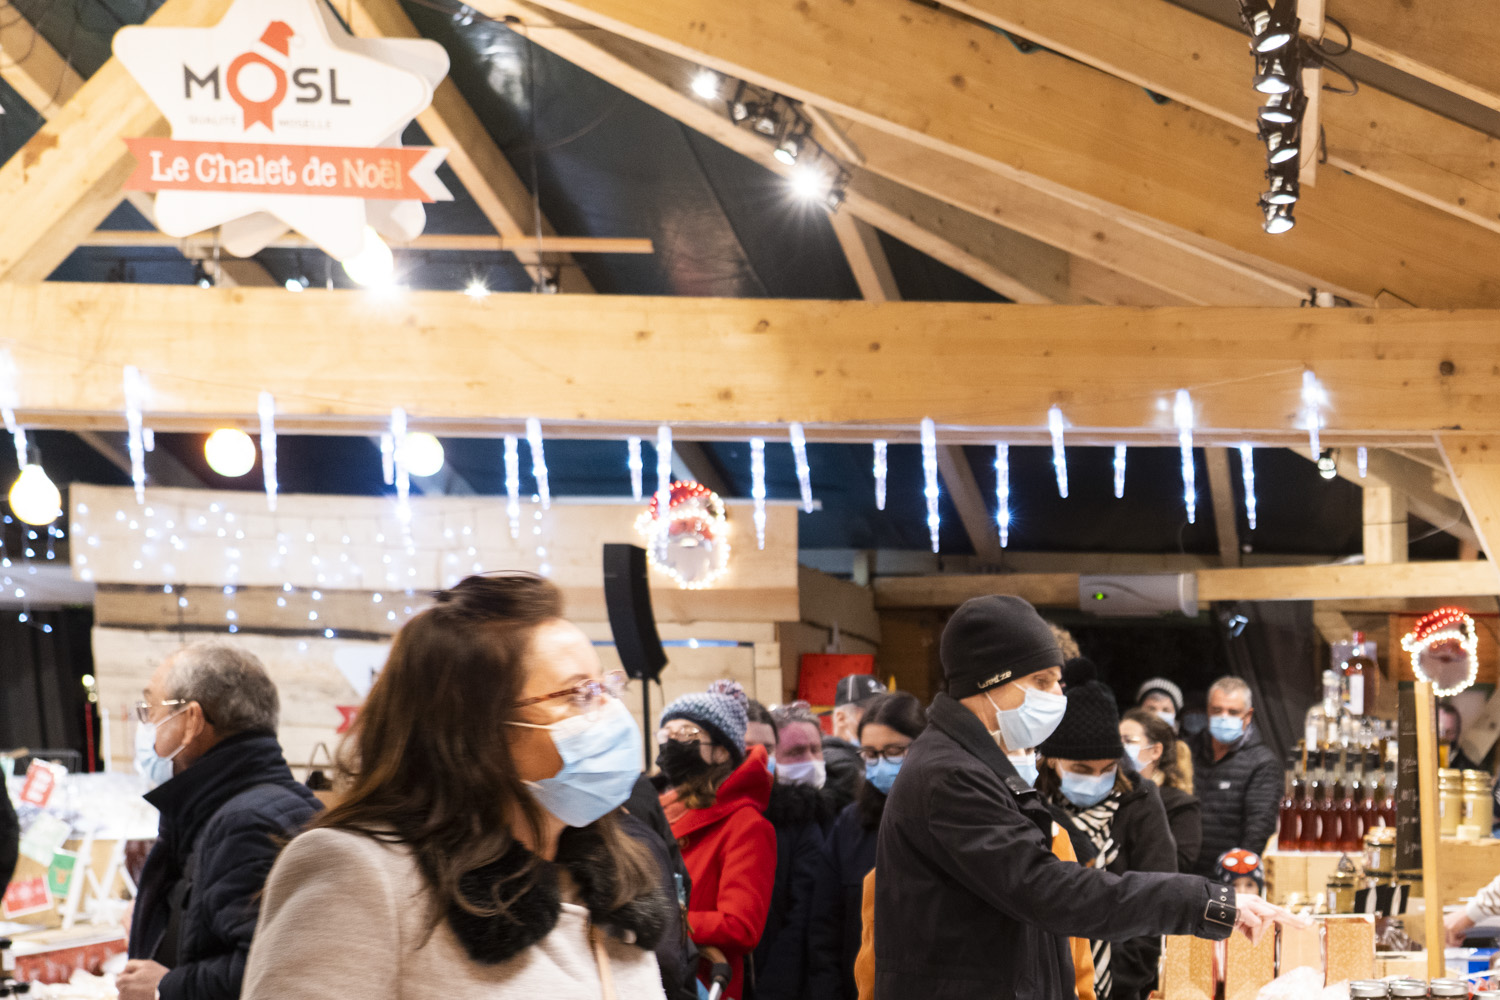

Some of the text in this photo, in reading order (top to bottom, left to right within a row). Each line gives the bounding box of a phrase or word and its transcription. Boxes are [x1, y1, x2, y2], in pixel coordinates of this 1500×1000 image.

[183, 52, 351, 105] MOSL
[150, 150, 403, 191] Le Chalet de Noël
